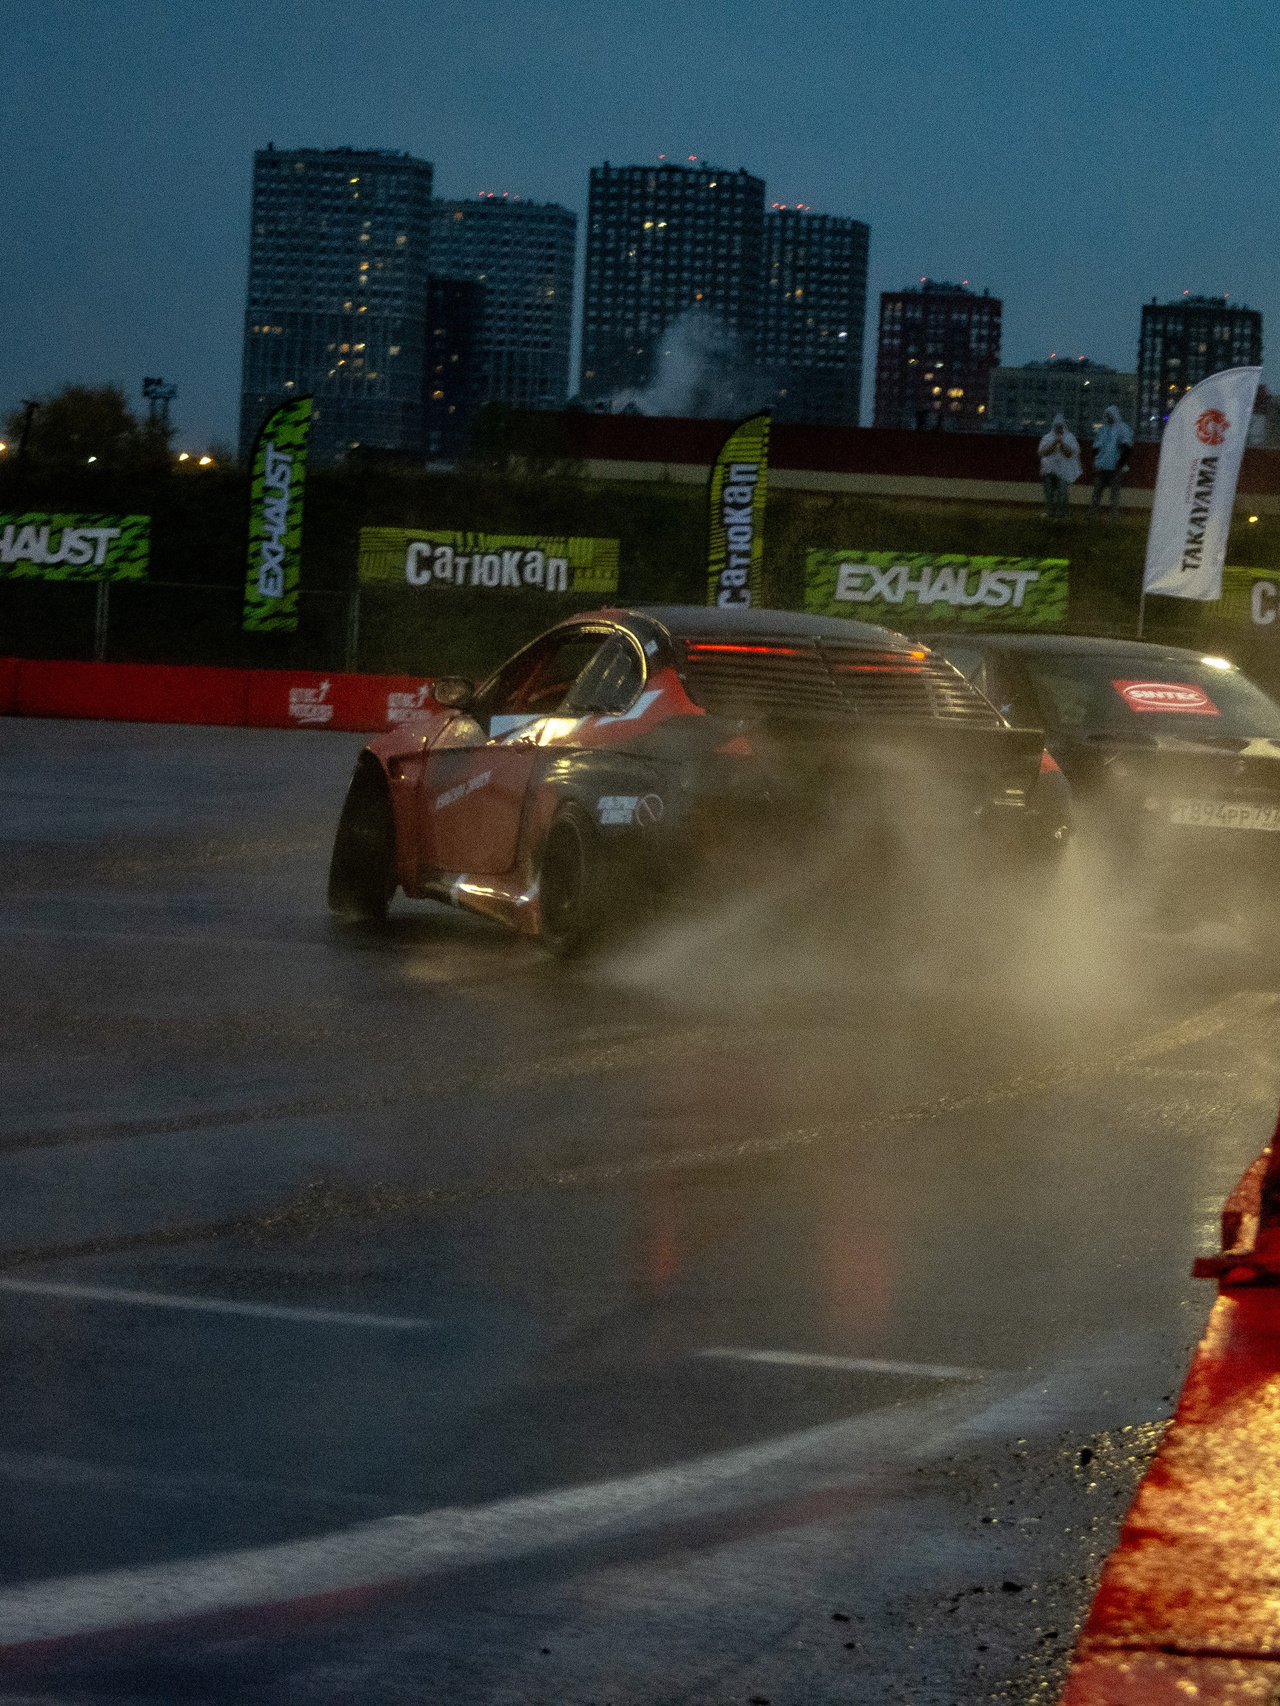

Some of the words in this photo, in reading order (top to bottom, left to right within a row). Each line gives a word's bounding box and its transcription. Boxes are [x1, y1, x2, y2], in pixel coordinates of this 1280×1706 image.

[258, 441, 293, 598] EXHAUST
[1181, 454, 1219, 573] TAKAYAMA
[835, 562, 1039, 608] EXHAUST
